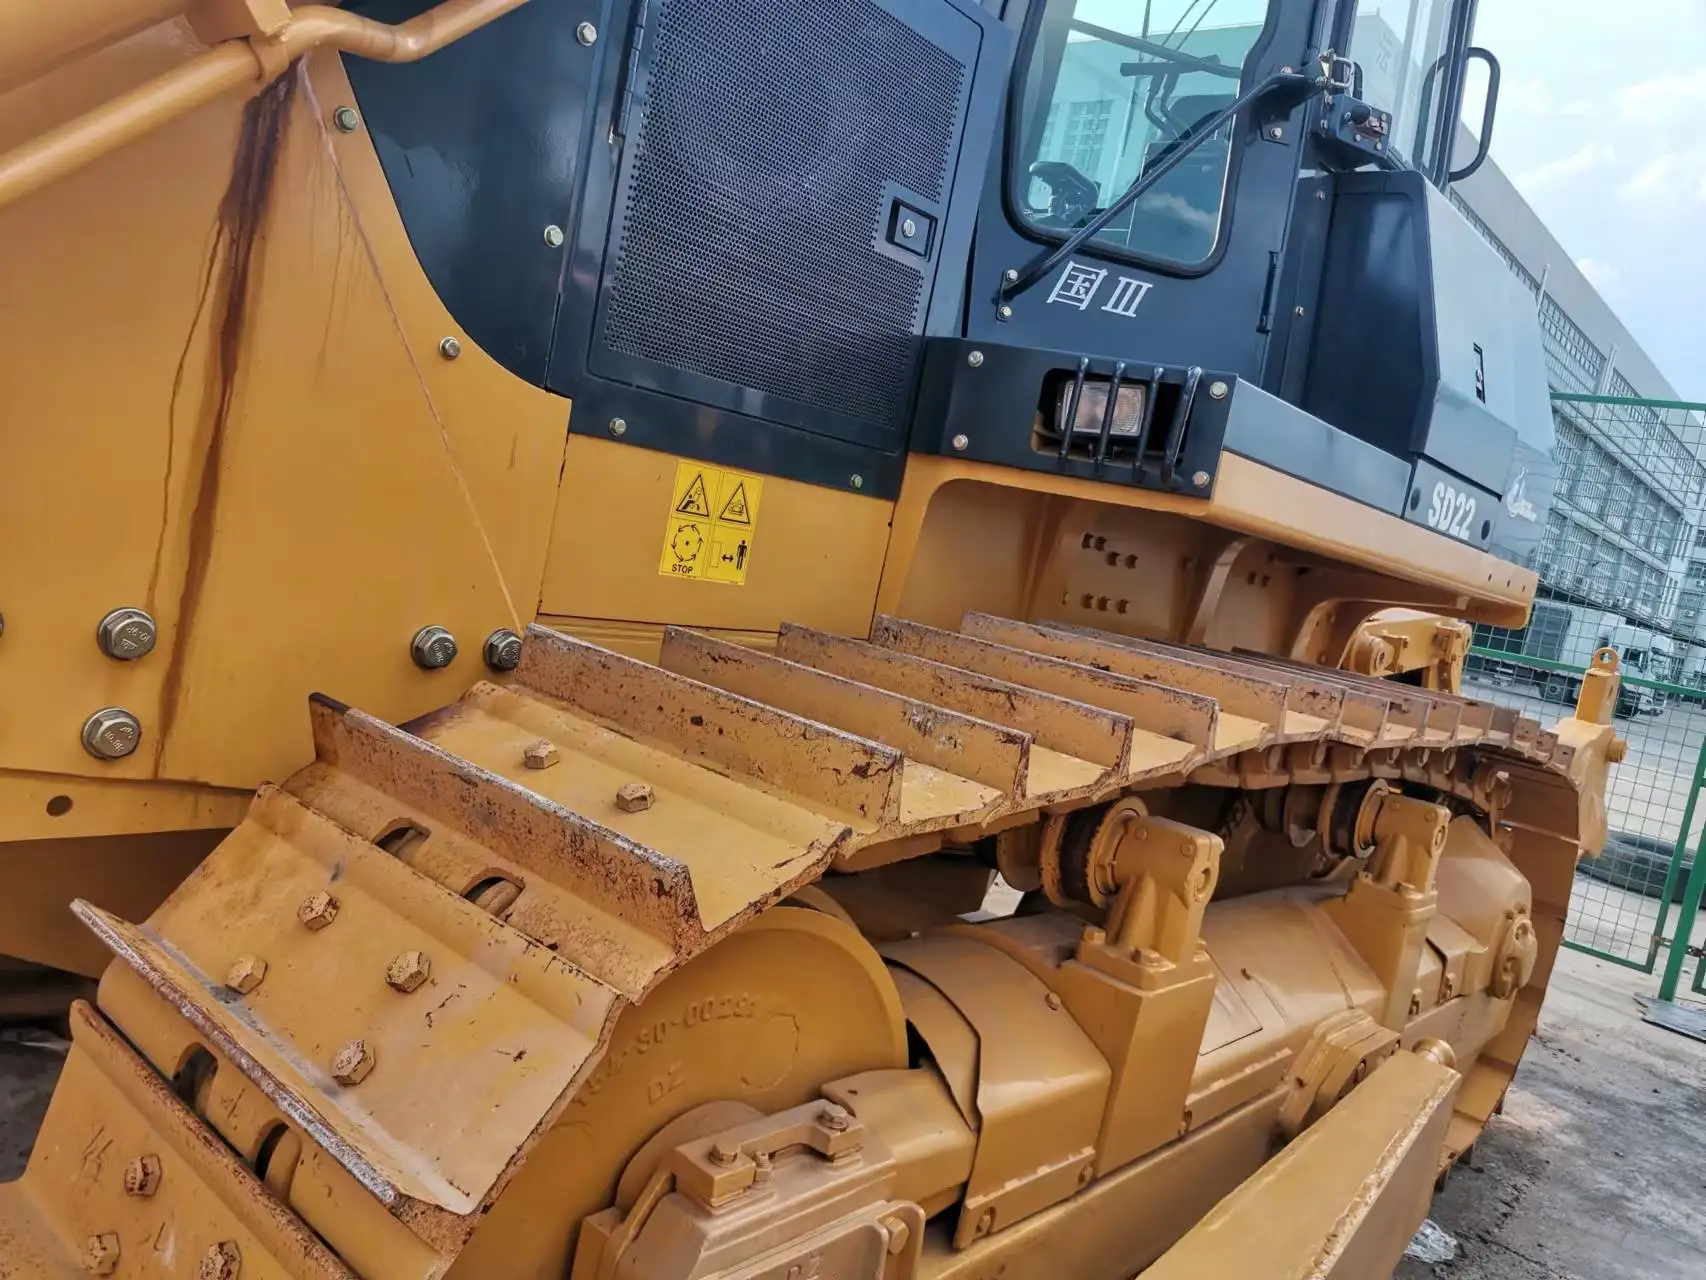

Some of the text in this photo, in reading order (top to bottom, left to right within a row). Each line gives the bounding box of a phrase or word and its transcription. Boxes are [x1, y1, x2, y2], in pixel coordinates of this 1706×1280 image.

[1046, 260, 1108, 310] 国
[1428, 481, 1476, 541] SD22
[671, 563, 694, 575] STOP
